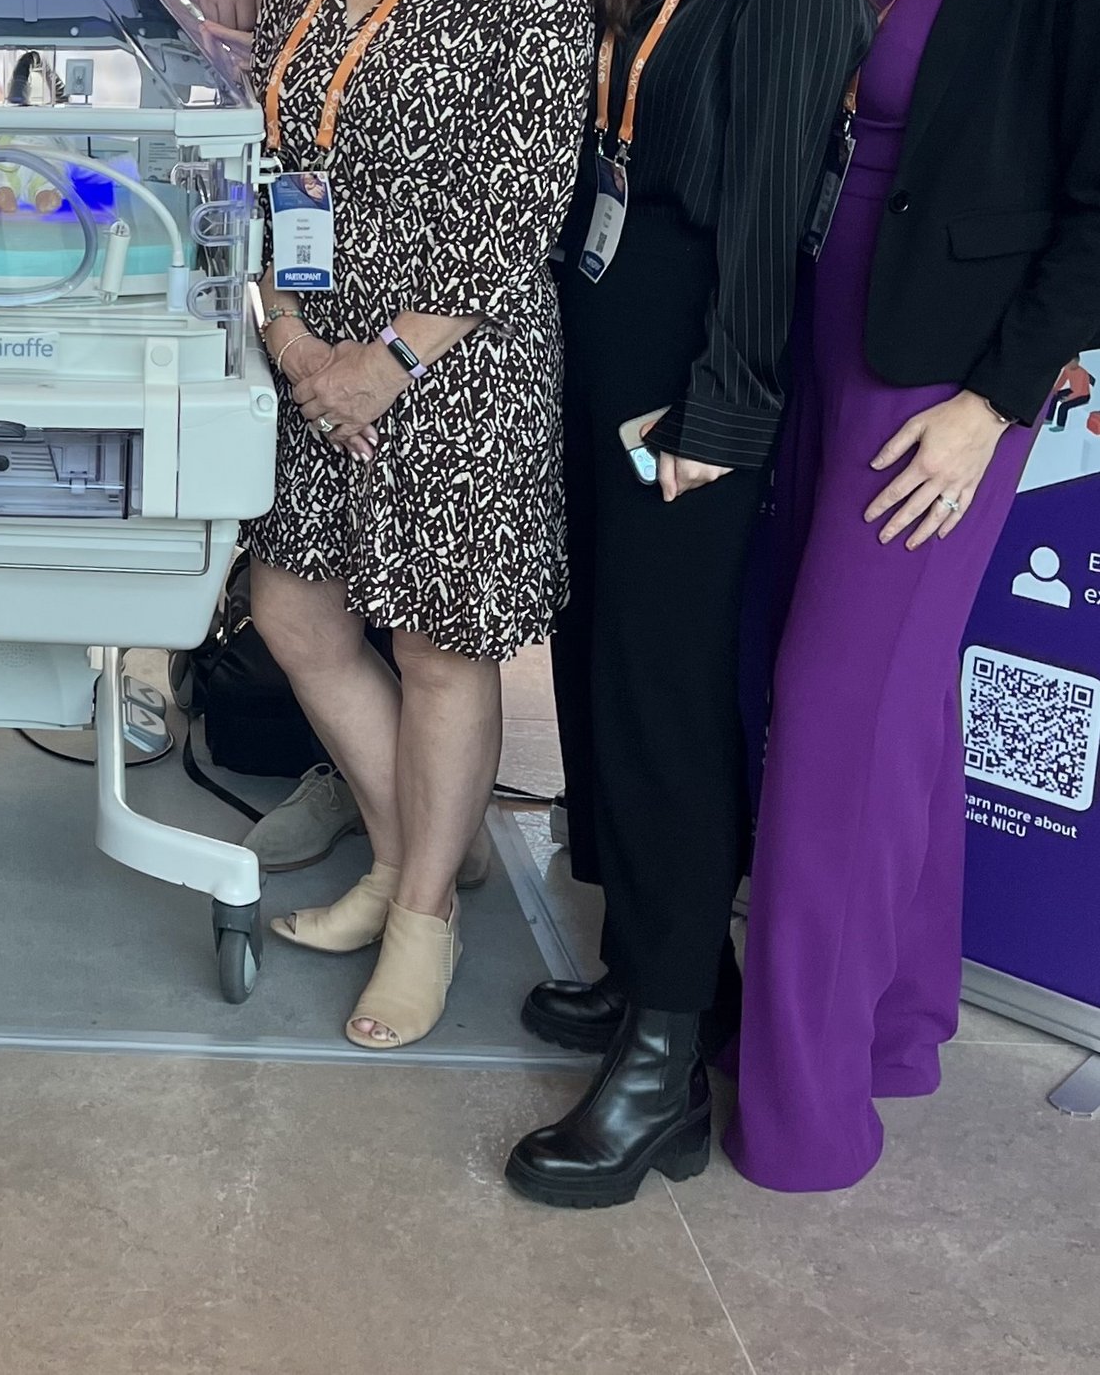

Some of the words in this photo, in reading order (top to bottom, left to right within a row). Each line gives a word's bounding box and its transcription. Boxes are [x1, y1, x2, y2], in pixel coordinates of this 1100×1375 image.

[350, 29, 373, 58] MCA
[628, 69, 639, 101] MCA
[323, 99, 338, 131] MCA
[284, 272, 322, 281] PARTICIPANT
[965, 793, 991, 811] arn
[994, 803, 1032, 823] more
[1034, 816, 1078, 839] about
[991, 816, 1026, 837] NICU
